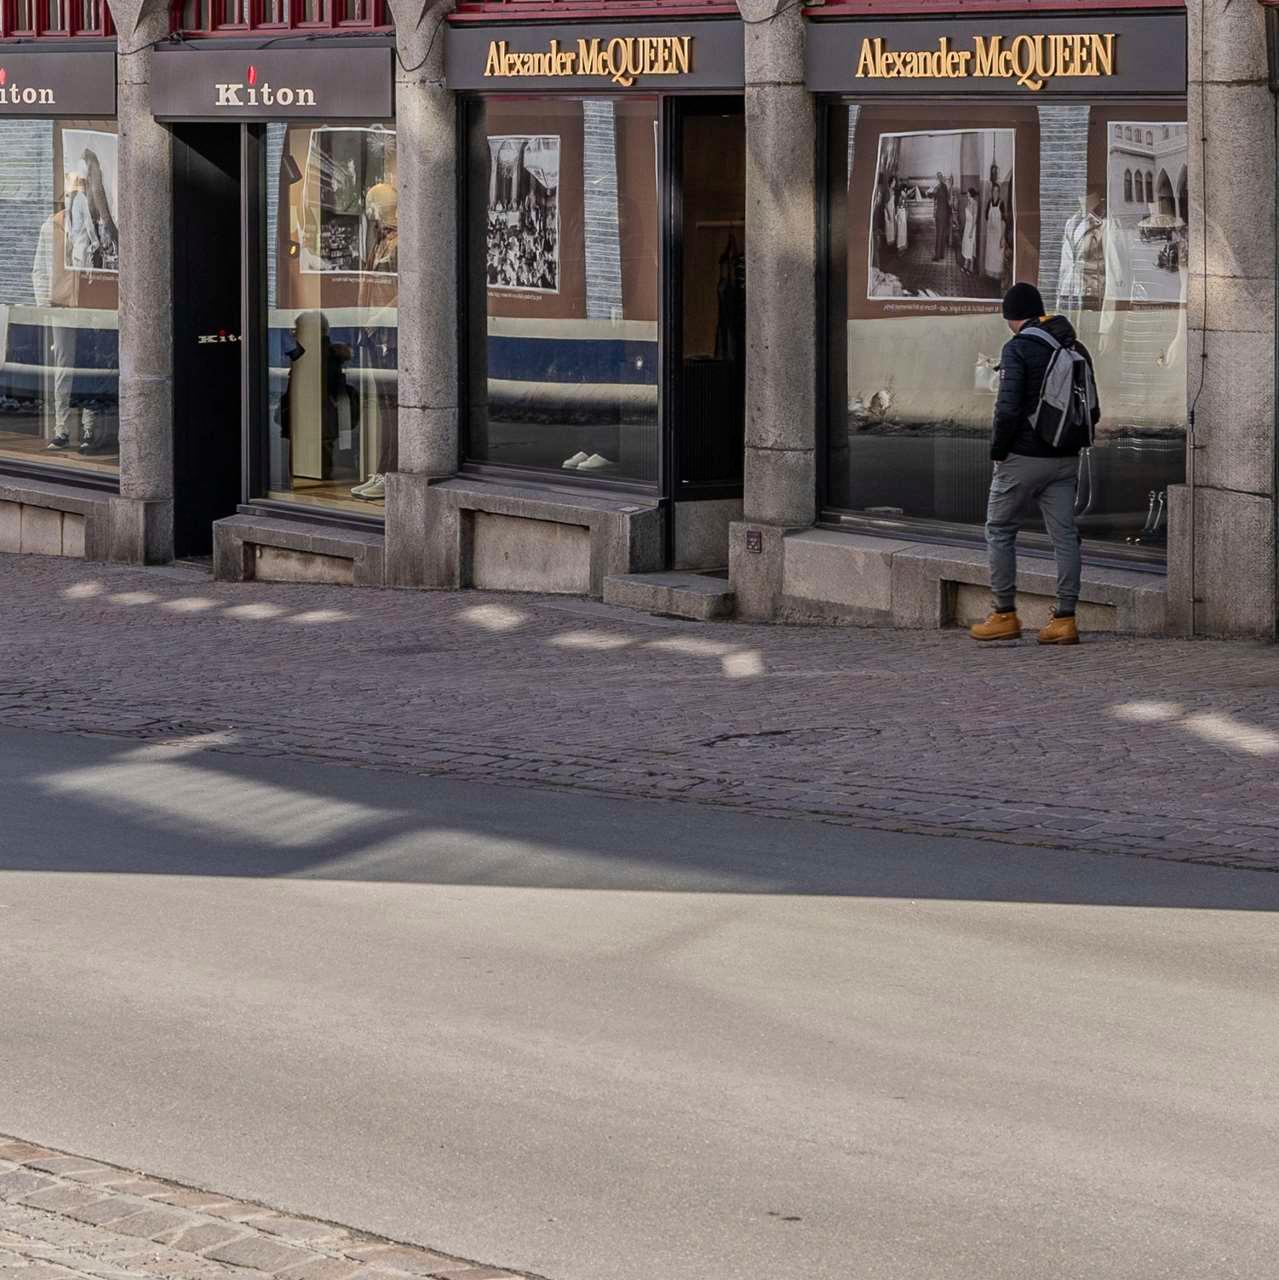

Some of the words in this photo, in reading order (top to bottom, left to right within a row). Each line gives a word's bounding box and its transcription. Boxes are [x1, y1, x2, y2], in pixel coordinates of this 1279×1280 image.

[215, 65, 317, 106] Kiton
[484, 39, 576, 77] Alexander
[577, 36, 691, 87] McQUEEN
[855, 36, 970, 78] Alexander
[972, 33, 1115, 91] McQUEEN
